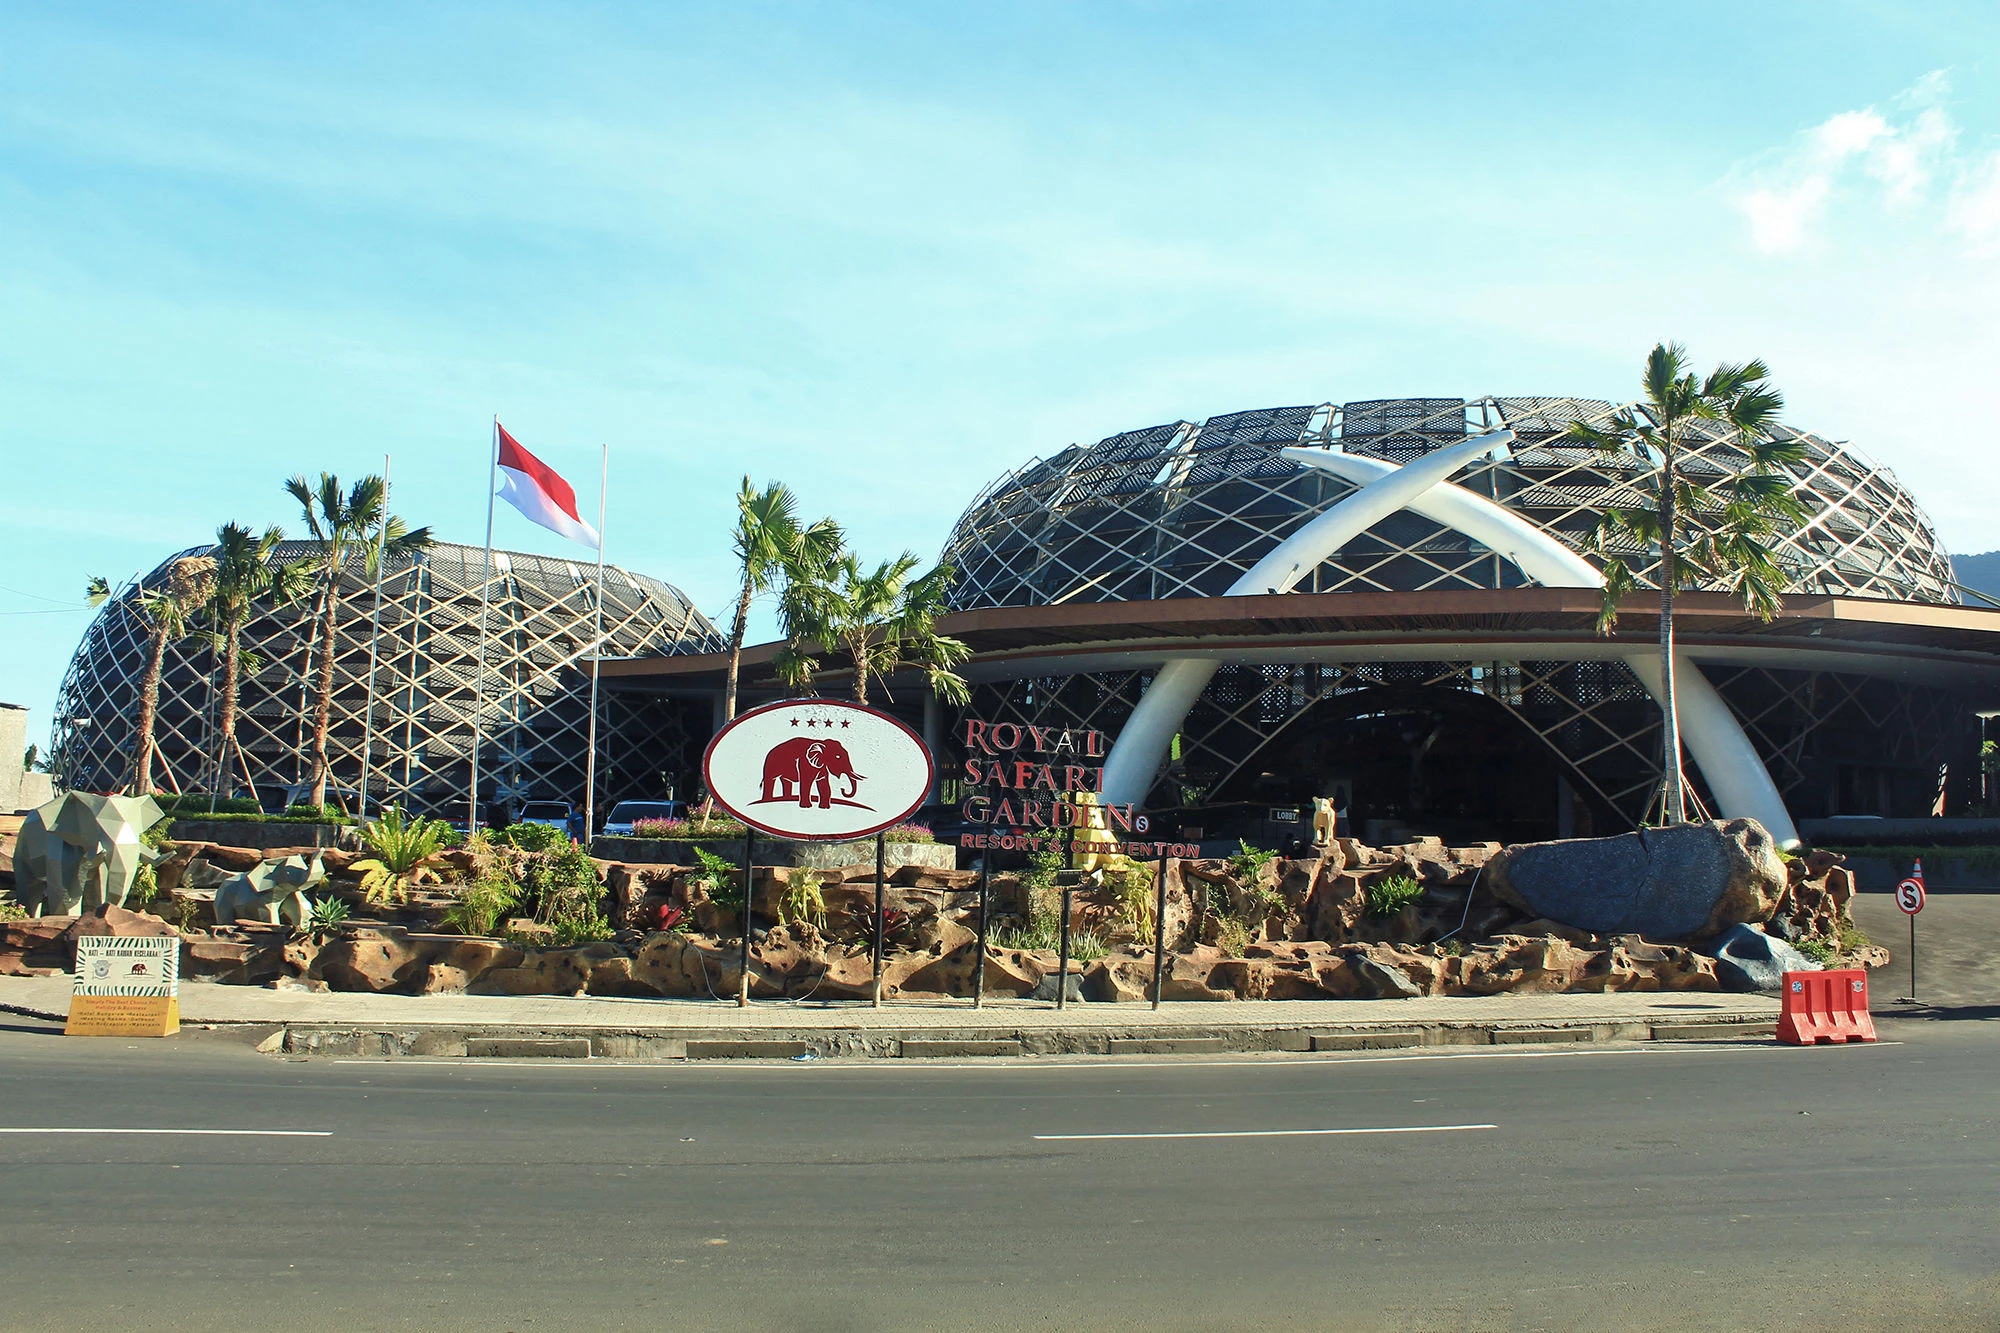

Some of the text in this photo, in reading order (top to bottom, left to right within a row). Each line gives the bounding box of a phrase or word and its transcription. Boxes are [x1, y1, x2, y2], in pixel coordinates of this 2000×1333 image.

[966, 719, 1104, 757] ROYAL
[964, 759, 1104, 794] SAFARI
[962, 796, 1134, 832] GARDEN
[1277, 811, 1297, 820] LOBBY
[961, 833, 1200, 858] RESORT & CONVENTION
